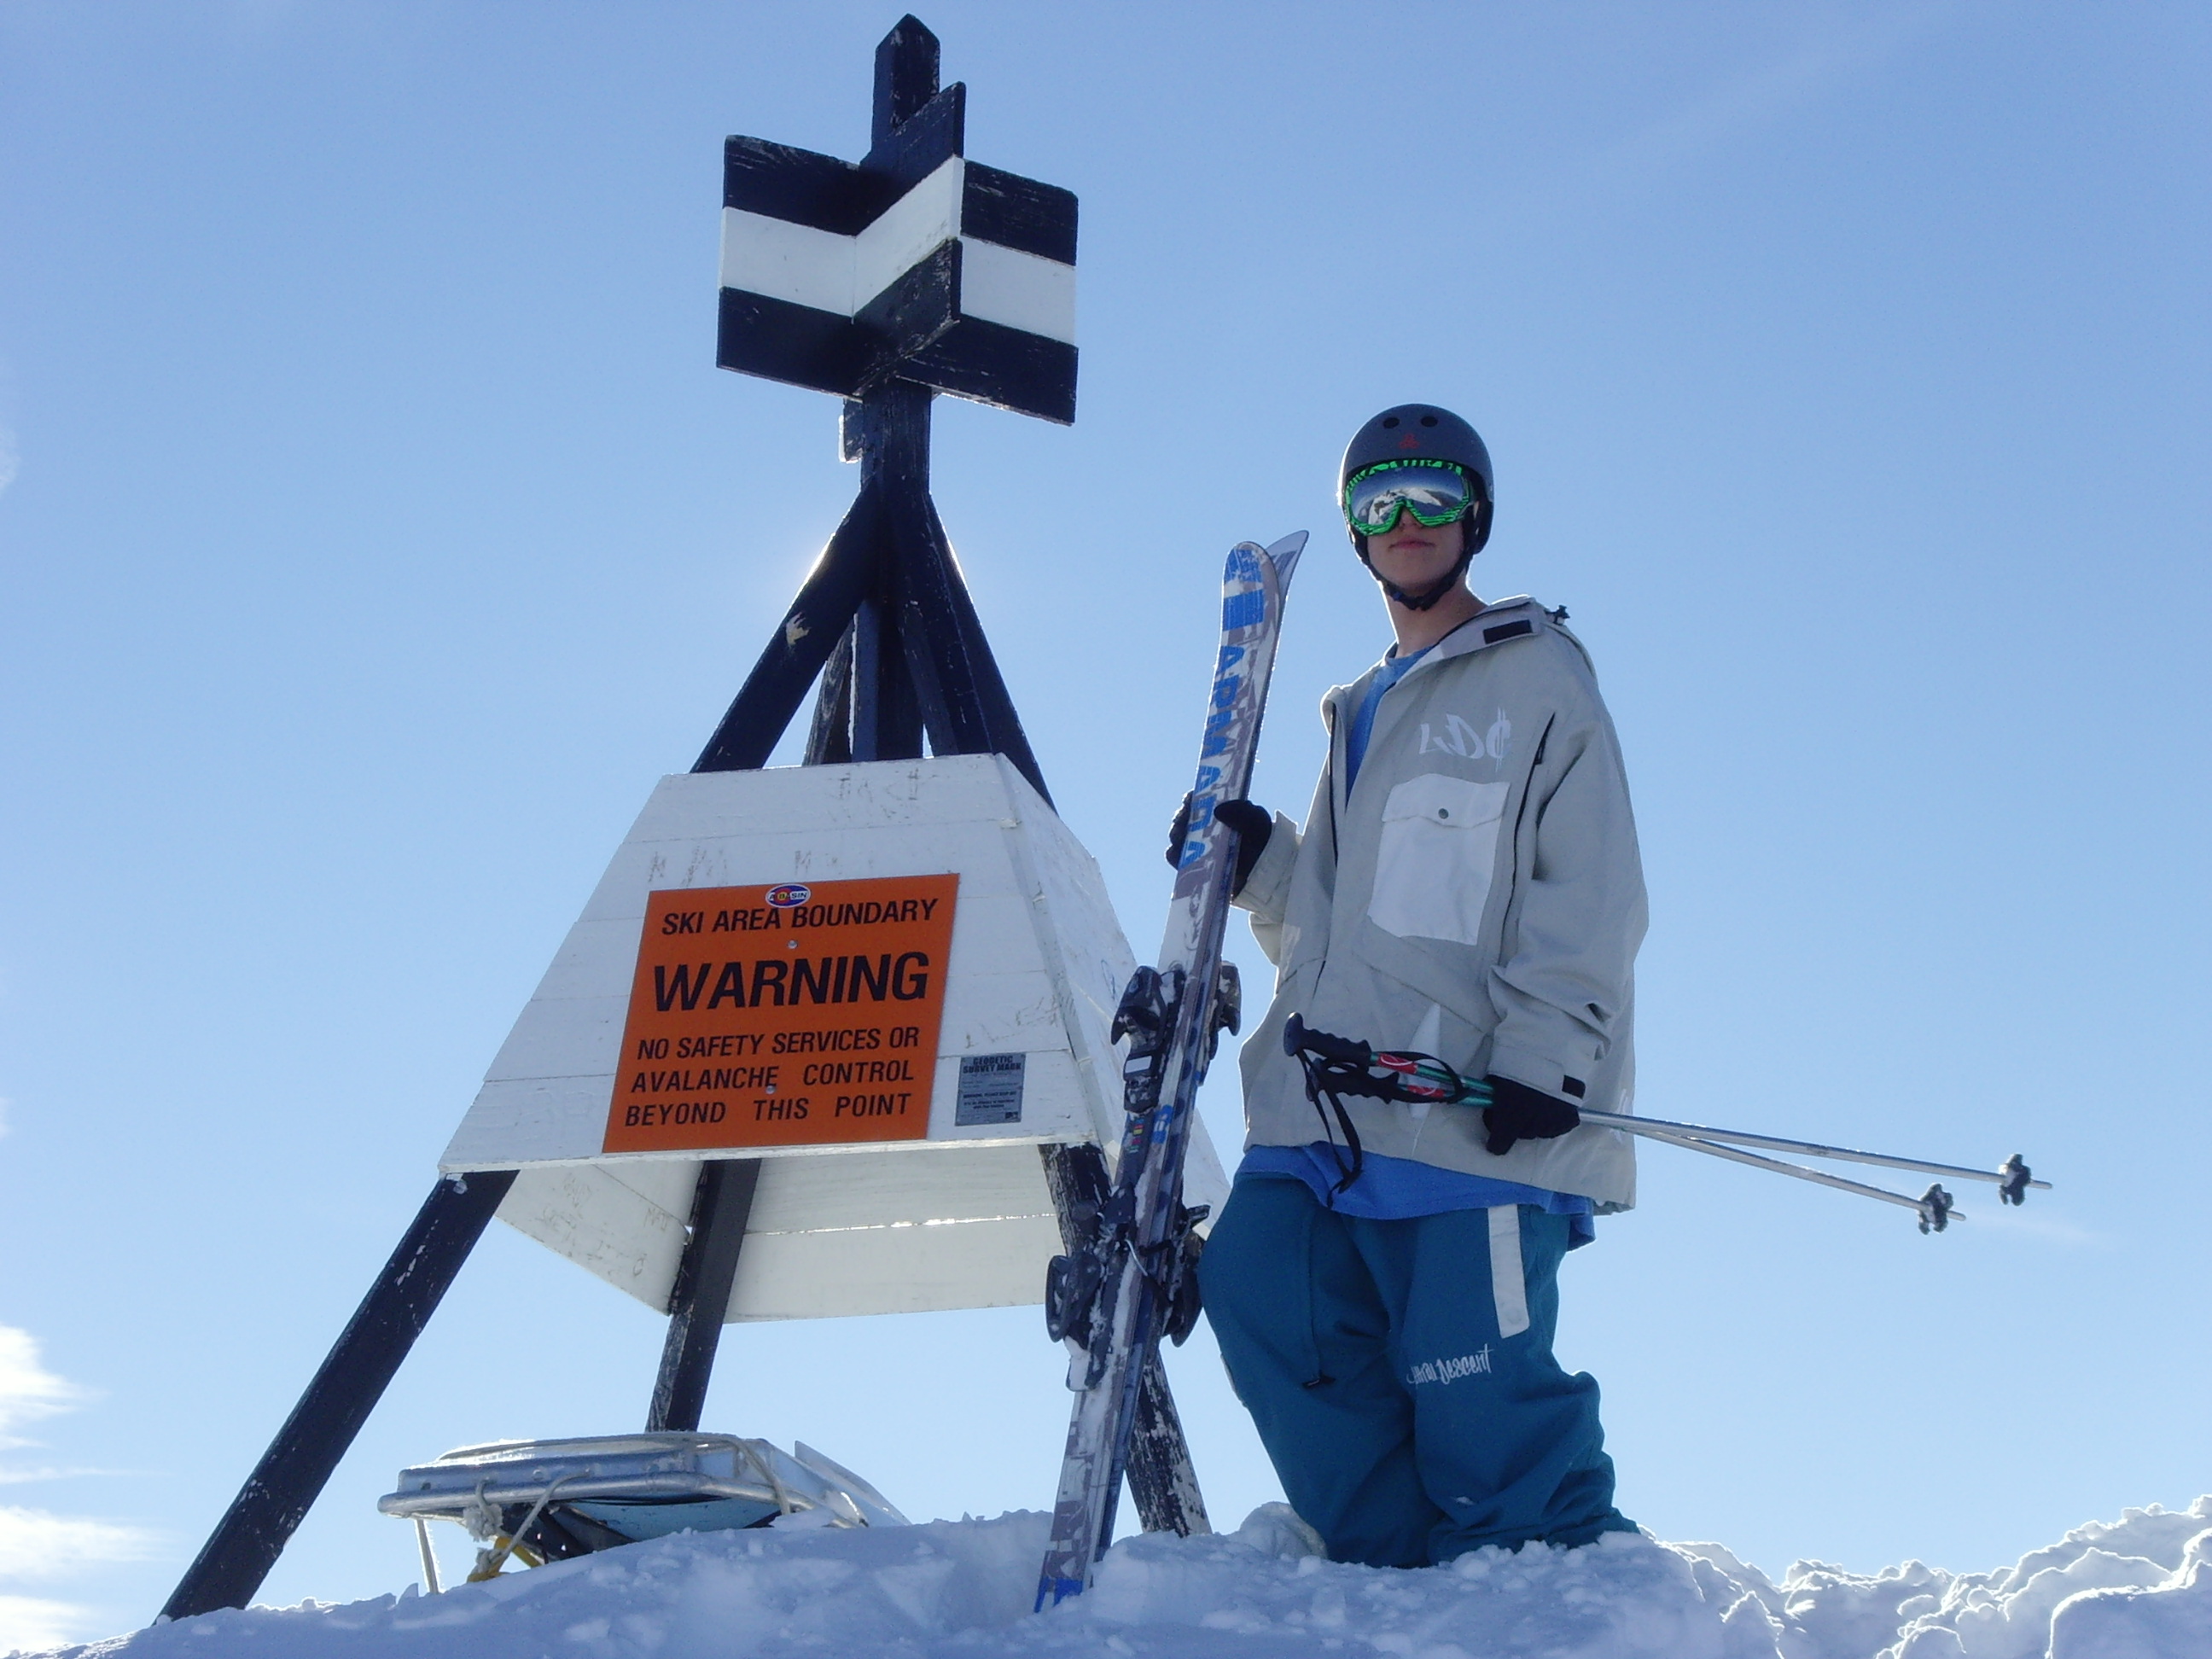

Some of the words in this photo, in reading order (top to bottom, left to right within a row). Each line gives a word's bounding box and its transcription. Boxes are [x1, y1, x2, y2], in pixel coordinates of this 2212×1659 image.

[661, 911, 704, 935] SKI
[712, 907, 781, 932] AREA
[791, 899, 939, 928] BOUNDARY
[654, 951, 930, 1012] WARNING
[637, 1038, 670, 1060] NO
[676, 1033, 765, 1058] SAFETY
[771, 1027, 881, 1054] SERVICES
[888, 1027, 920, 1048] OR
[631, 1066, 780, 1093] AVALANCHE
[803, 1060, 915, 1086] CONTROL
[625, 1101, 726, 1127] BEYOND
[754, 1097, 809, 1121] THIS
[834, 1093, 912, 1118] POINT
